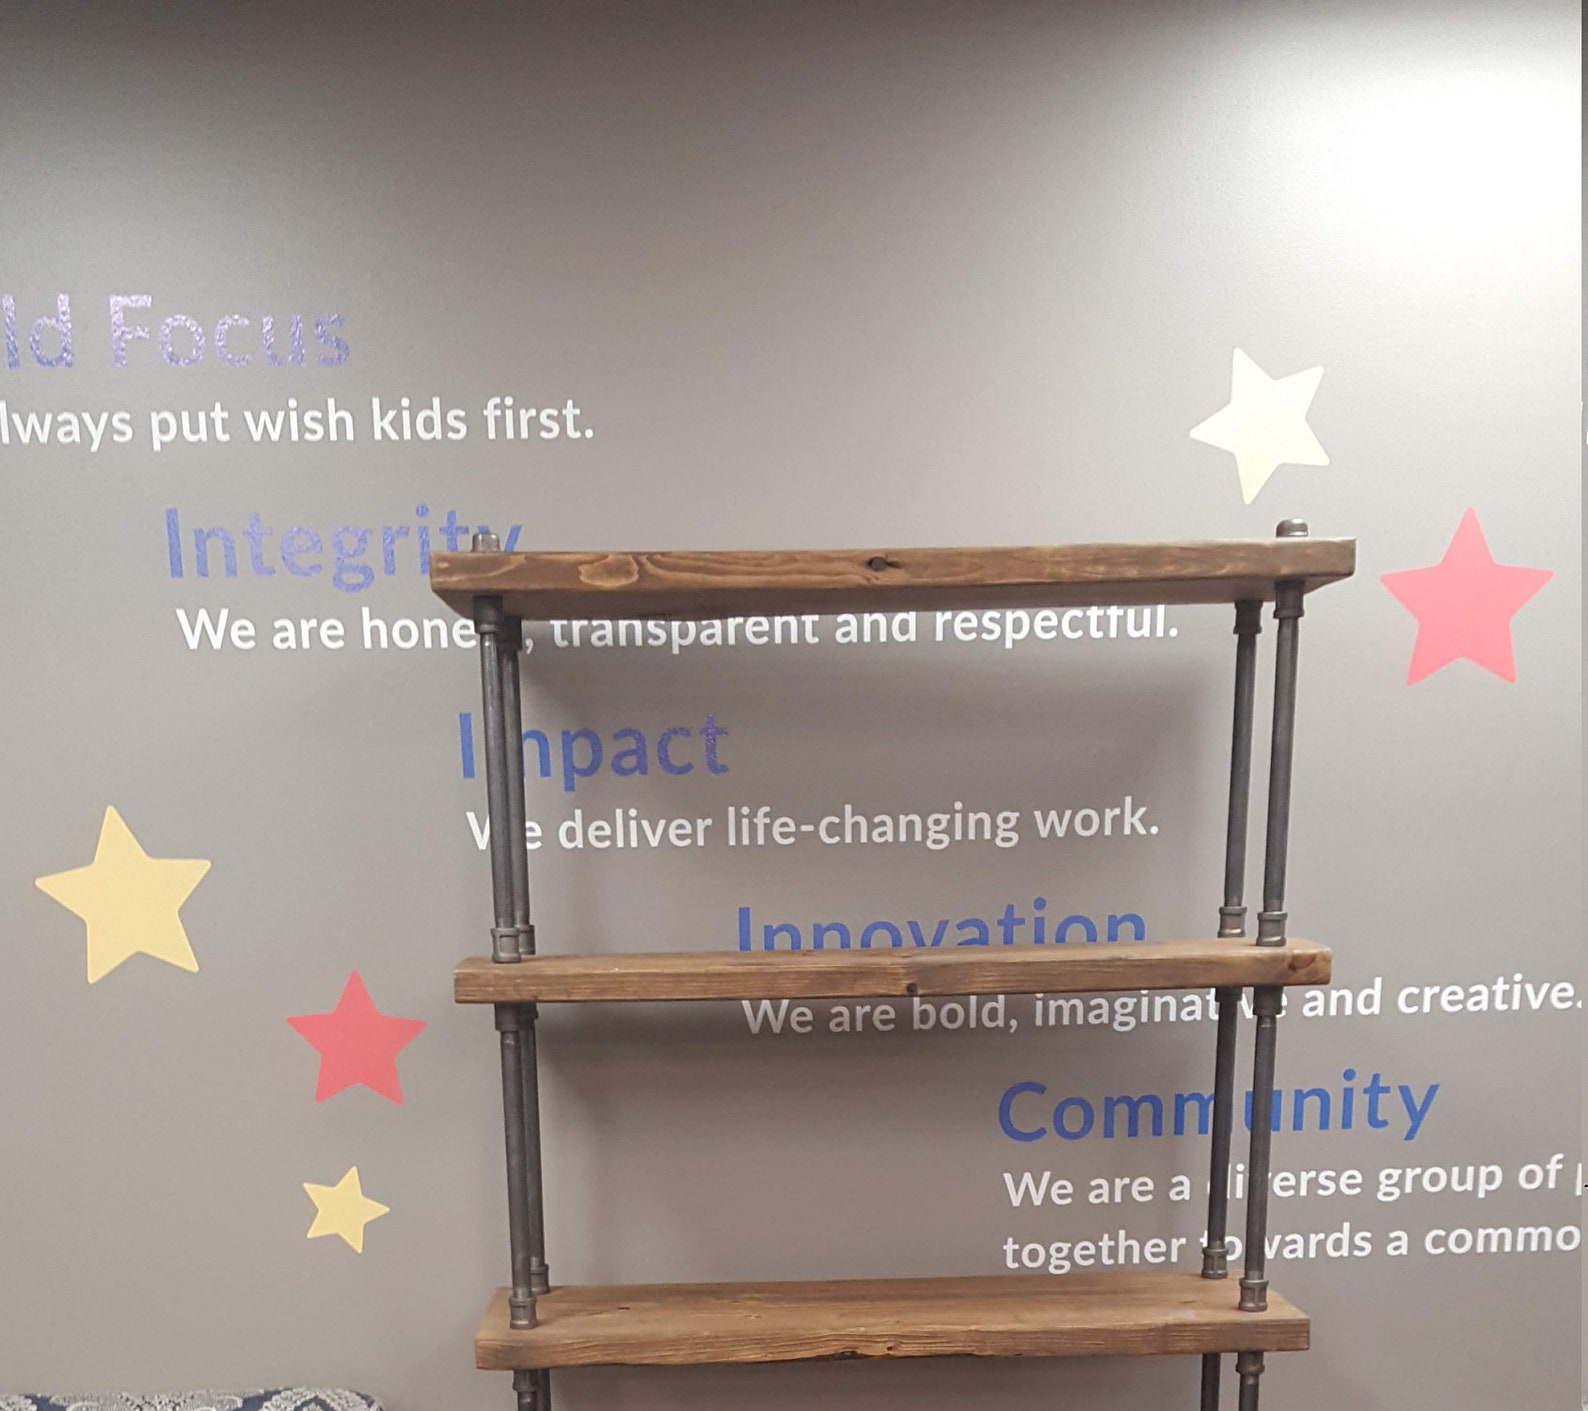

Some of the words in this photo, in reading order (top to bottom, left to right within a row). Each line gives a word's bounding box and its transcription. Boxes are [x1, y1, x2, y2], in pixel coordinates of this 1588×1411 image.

[2, 293, 73, 369] ld
[108, 294, 350, 369] Focus
[0, 401, 132, 451] lways
[151, 403, 229, 450] put
[244, 398, 353, 441] wish
[372, 397, 466, 440] kids
[483, 397, 593, 439] first.
[176, 608, 255, 649] We
[273, 619, 344, 649] are
[363, 608, 534, 655] hone,
[549, 614, 819, 654] transparent
[836, 611, 916, 643] and
[936, 605, 1177, 648] respectful.
[559, 808, 712, 849] deliver
[728, 801, 1019, 850] life-changing
[1034, 796, 1159, 837] work.
[738, 898, 1145, 951] Innovation
[741, 999, 813, 1033] We
[830, 1005, 895, 1032] are
[913, 999, 1017, 1033] bold,
[1303, 977, 1382, 1016] and
[1398, 973, 1582, 1013] creative.
[1003, 1171, 1073, 1206] We
[1088, 1177, 1154, 1204] are
[1169, 1175, 1190, 1200] a
[1207, 1164, 1362, 1199] ierse
[1377, 1165, 1502, 1201] group
[1519, 1154, 1564, 1189] of
[1003, 1228, 1186, 1274] together
[1387, 1231, 1408, 1255] a
[1425, 1226, 1580, 1254] commo
